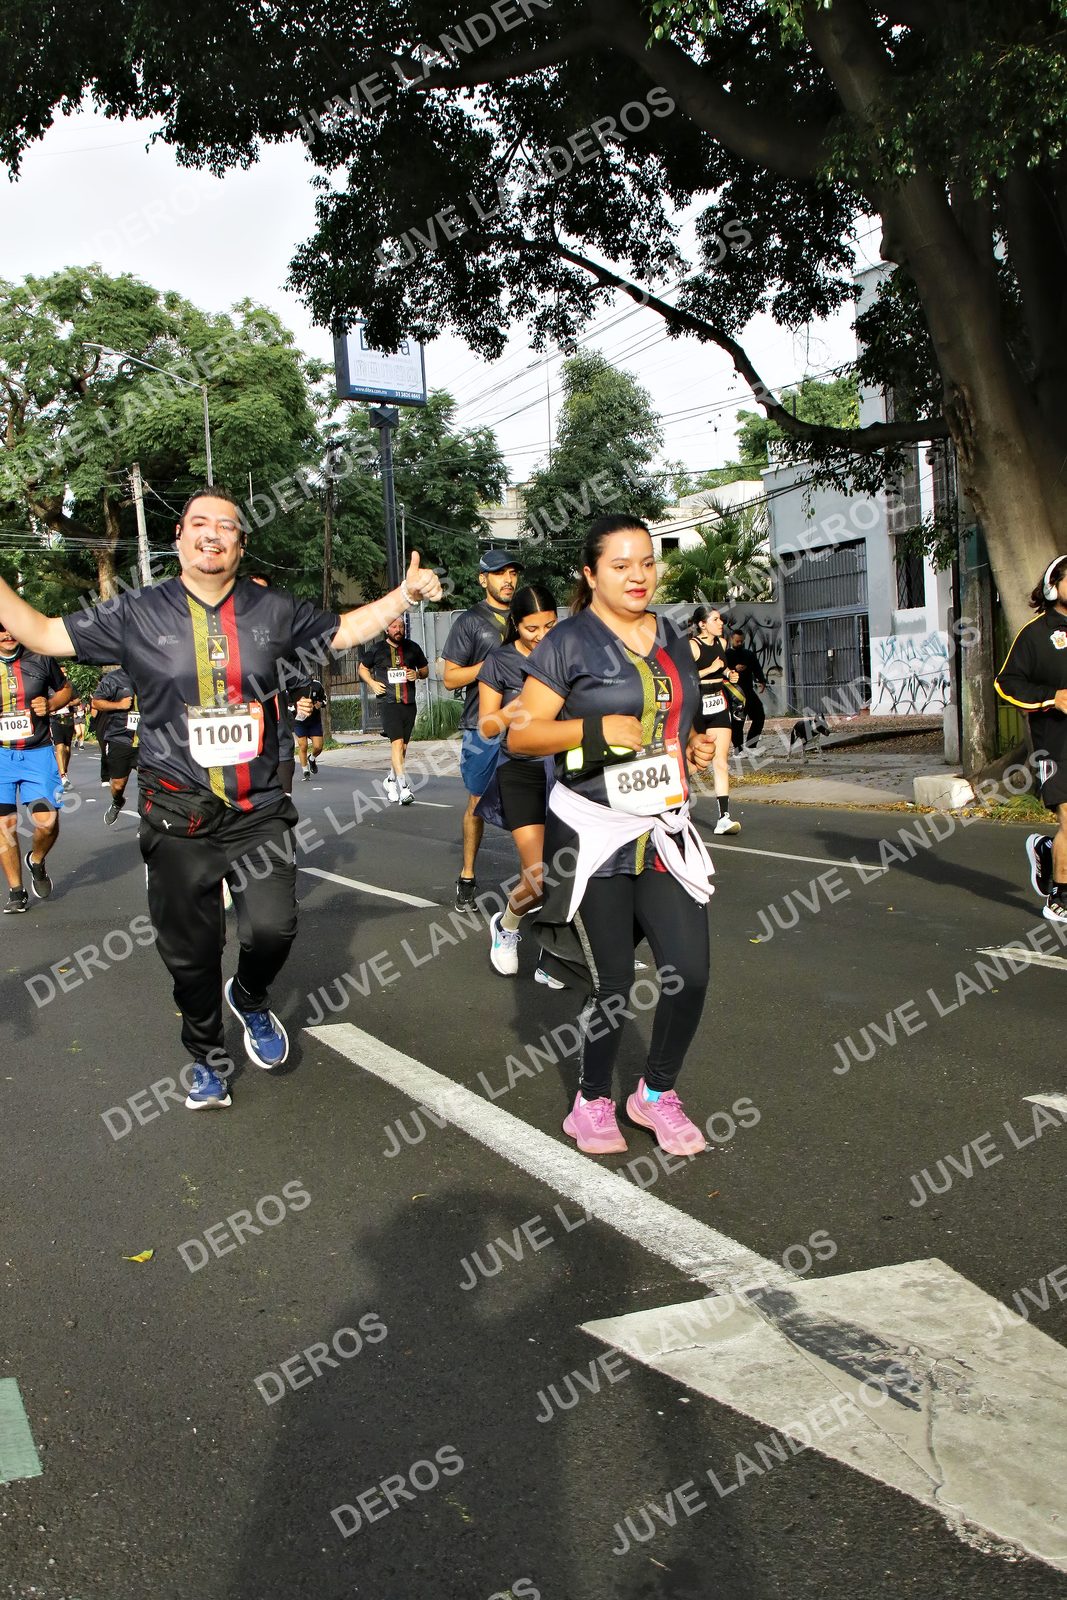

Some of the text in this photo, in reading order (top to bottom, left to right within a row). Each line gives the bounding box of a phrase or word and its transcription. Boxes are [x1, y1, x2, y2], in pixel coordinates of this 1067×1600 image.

[704, 697, 724, 709] 13201
[193, 723, 253, 746] 11001
[617, 763, 671, 794] 8884
